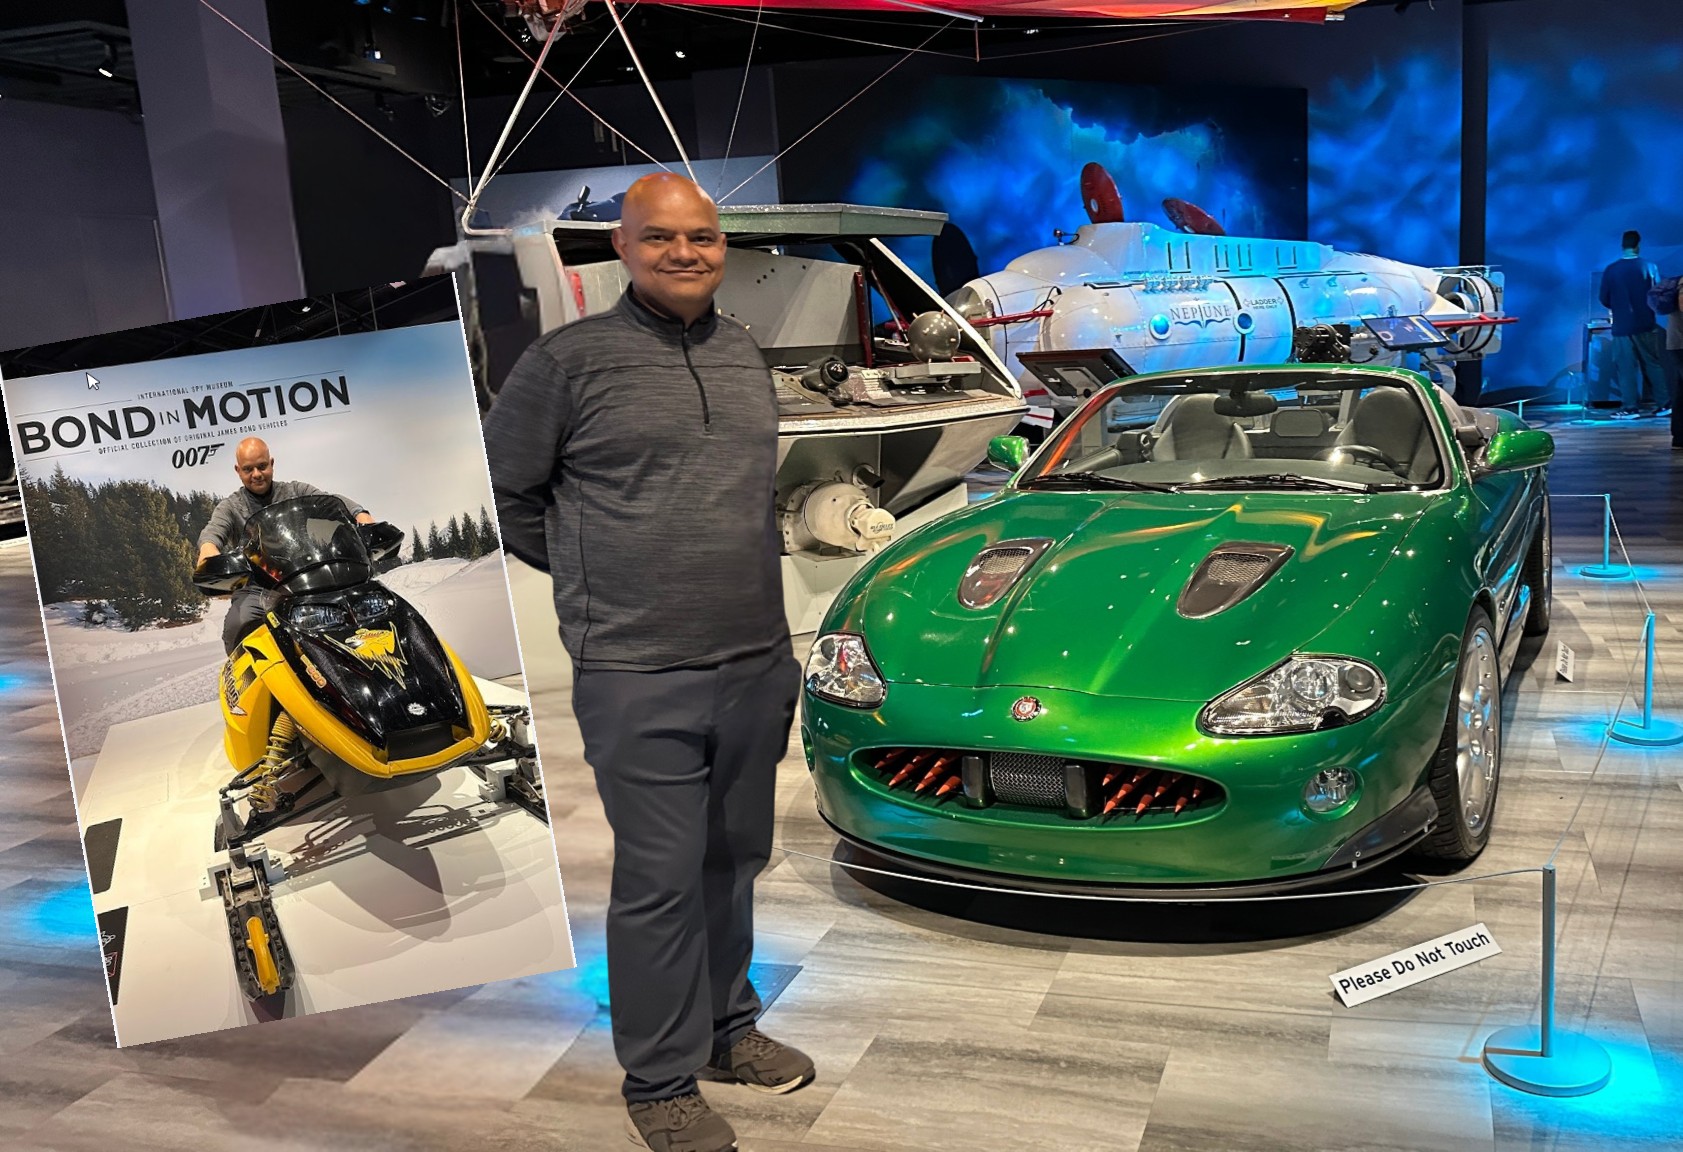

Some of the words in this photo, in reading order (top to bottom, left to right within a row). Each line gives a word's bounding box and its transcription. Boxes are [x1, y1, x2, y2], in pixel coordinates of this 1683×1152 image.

[1170, 304, 1232, 321] NEPTUNE
[137, 386, 189, 400] INTERNATIONAL
[191, 384, 204, 393] SPY
[206, 380, 234, 391] MUSEUM
[16, 405, 156, 455] BOND
[159, 409, 181, 426] IN
[183, 375, 351, 430] MOTION
[98, 444, 129, 455] OFFICIAL
[131, 437, 172, 450] COLLECTION
[174, 435, 182, 443] OF
[184, 432, 215, 443] ORIGINAL
[217, 427, 238, 437] JAMES
[239, 424, 257, 434] BOND
[258, 419, 288, 431] VEHICLES
[172, 443, 225, 469] 007
[1338, 967, 1392, 994] Please
[1392, 960, 1415, 975] Do
[1415, 946, 1446, 967] Not
[1444, 932, 1490, 956] Touch
